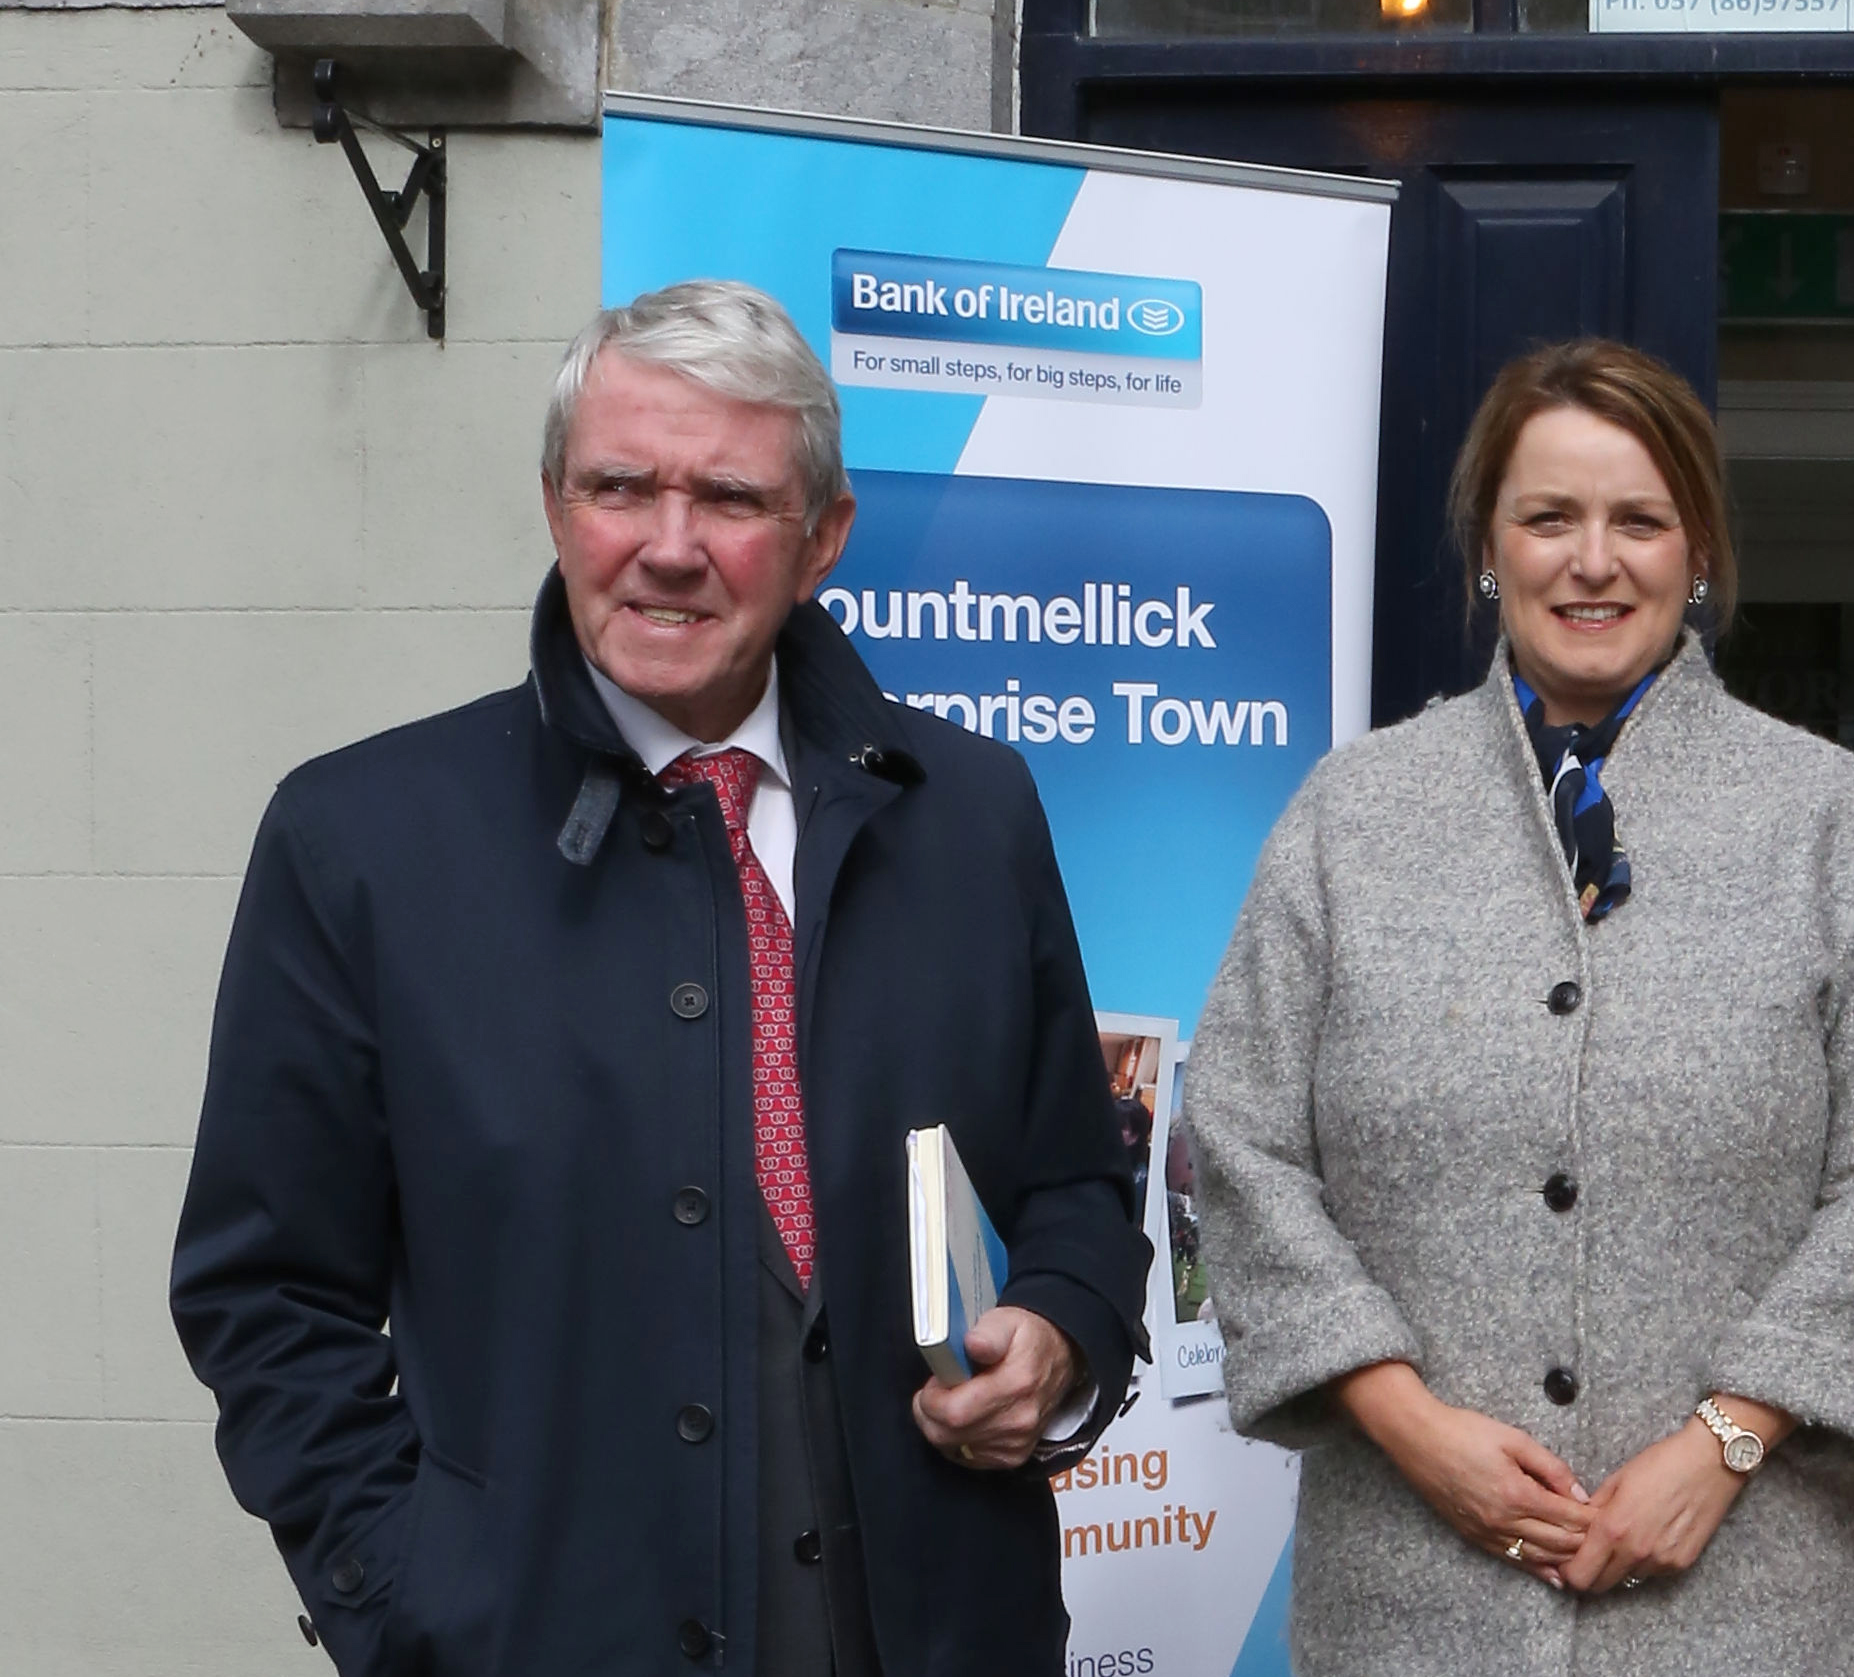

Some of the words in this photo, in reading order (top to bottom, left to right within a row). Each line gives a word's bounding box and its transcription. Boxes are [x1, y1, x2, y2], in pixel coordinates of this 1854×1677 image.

[852, 273, 948, 316] Bank
[954, 284, 994, 319] of
[999, 286, 1120, 331] Ireland
[853, 350, 886, 371] For
[890, 355, 940, 375] small
[945, 358, 1002, 383] steps,
[1007, 362, 1032, 382] for
[1036, 364, 1064, 389] big
[1068, 367, 1122, 392] steps,
[1125, 372, 1151, 392] for
[1155, 374, 1182, 395] life
[1112, 680, 1288, 747] Town
